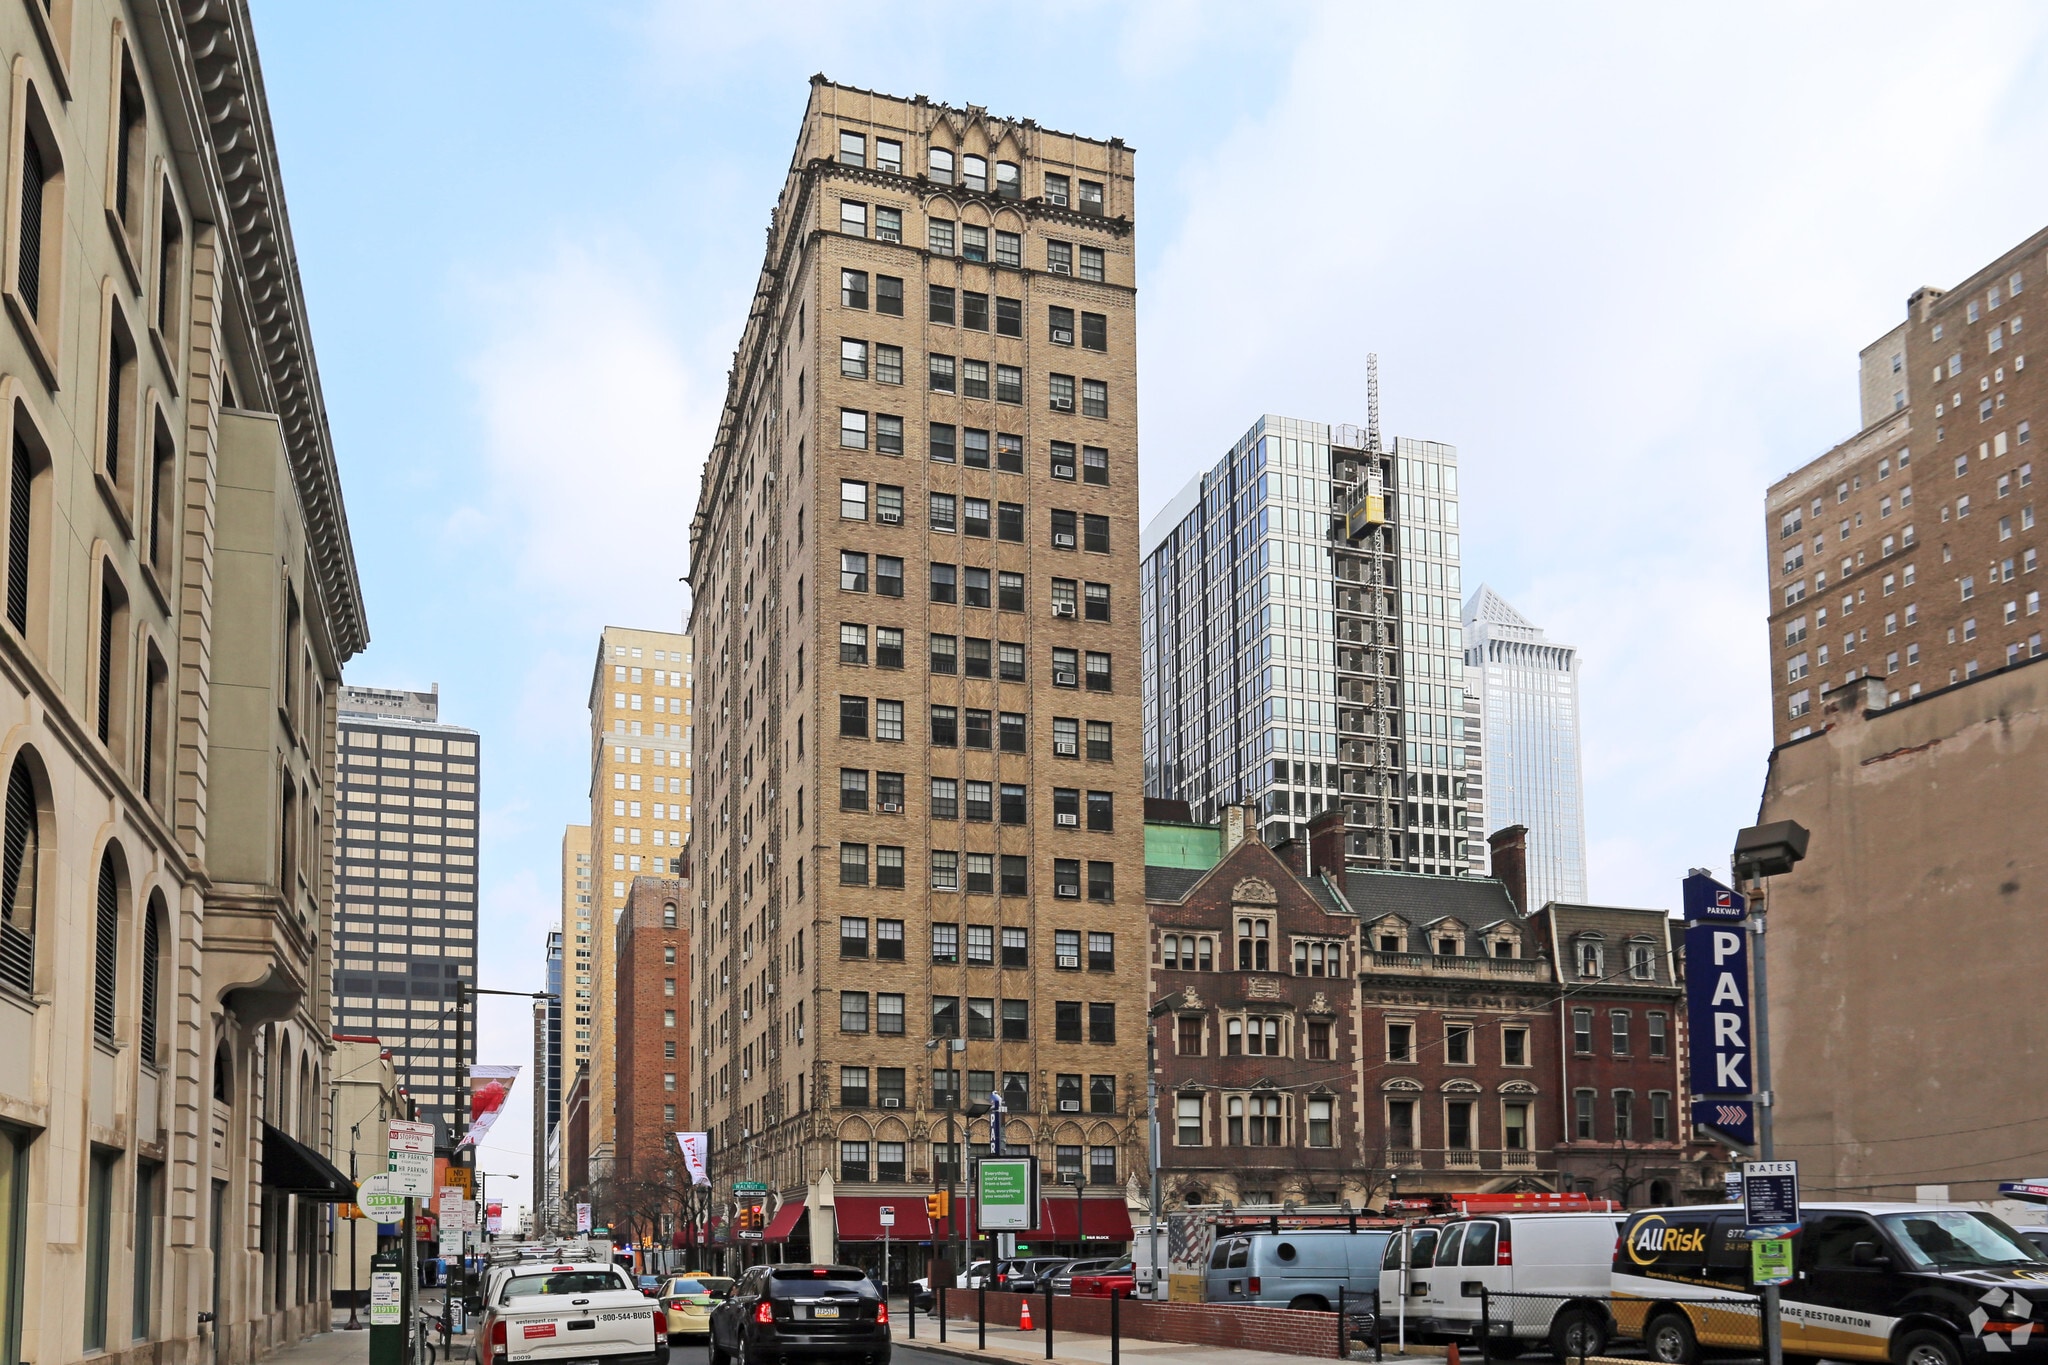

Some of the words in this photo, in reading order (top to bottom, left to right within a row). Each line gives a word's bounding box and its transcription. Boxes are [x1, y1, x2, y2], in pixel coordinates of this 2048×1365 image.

[1707, 906, 1740, 916] PARKWAY
[1711, 931, 1748, 1088] PARK
[399, 1133, 423, 1142] STOPPING
[1750, 1164, 1792, 1172] RATES
[367, 1196, 404, 1204] 919117
[1636, 1228, 1706, 1251] AllRisk
[596, 1312, 651, 1322] 1-800-544-BUGS
[1779, 1306, 1802, 1316] MAGE
[1805, 1310, 1871, 1328] RESTORATION
